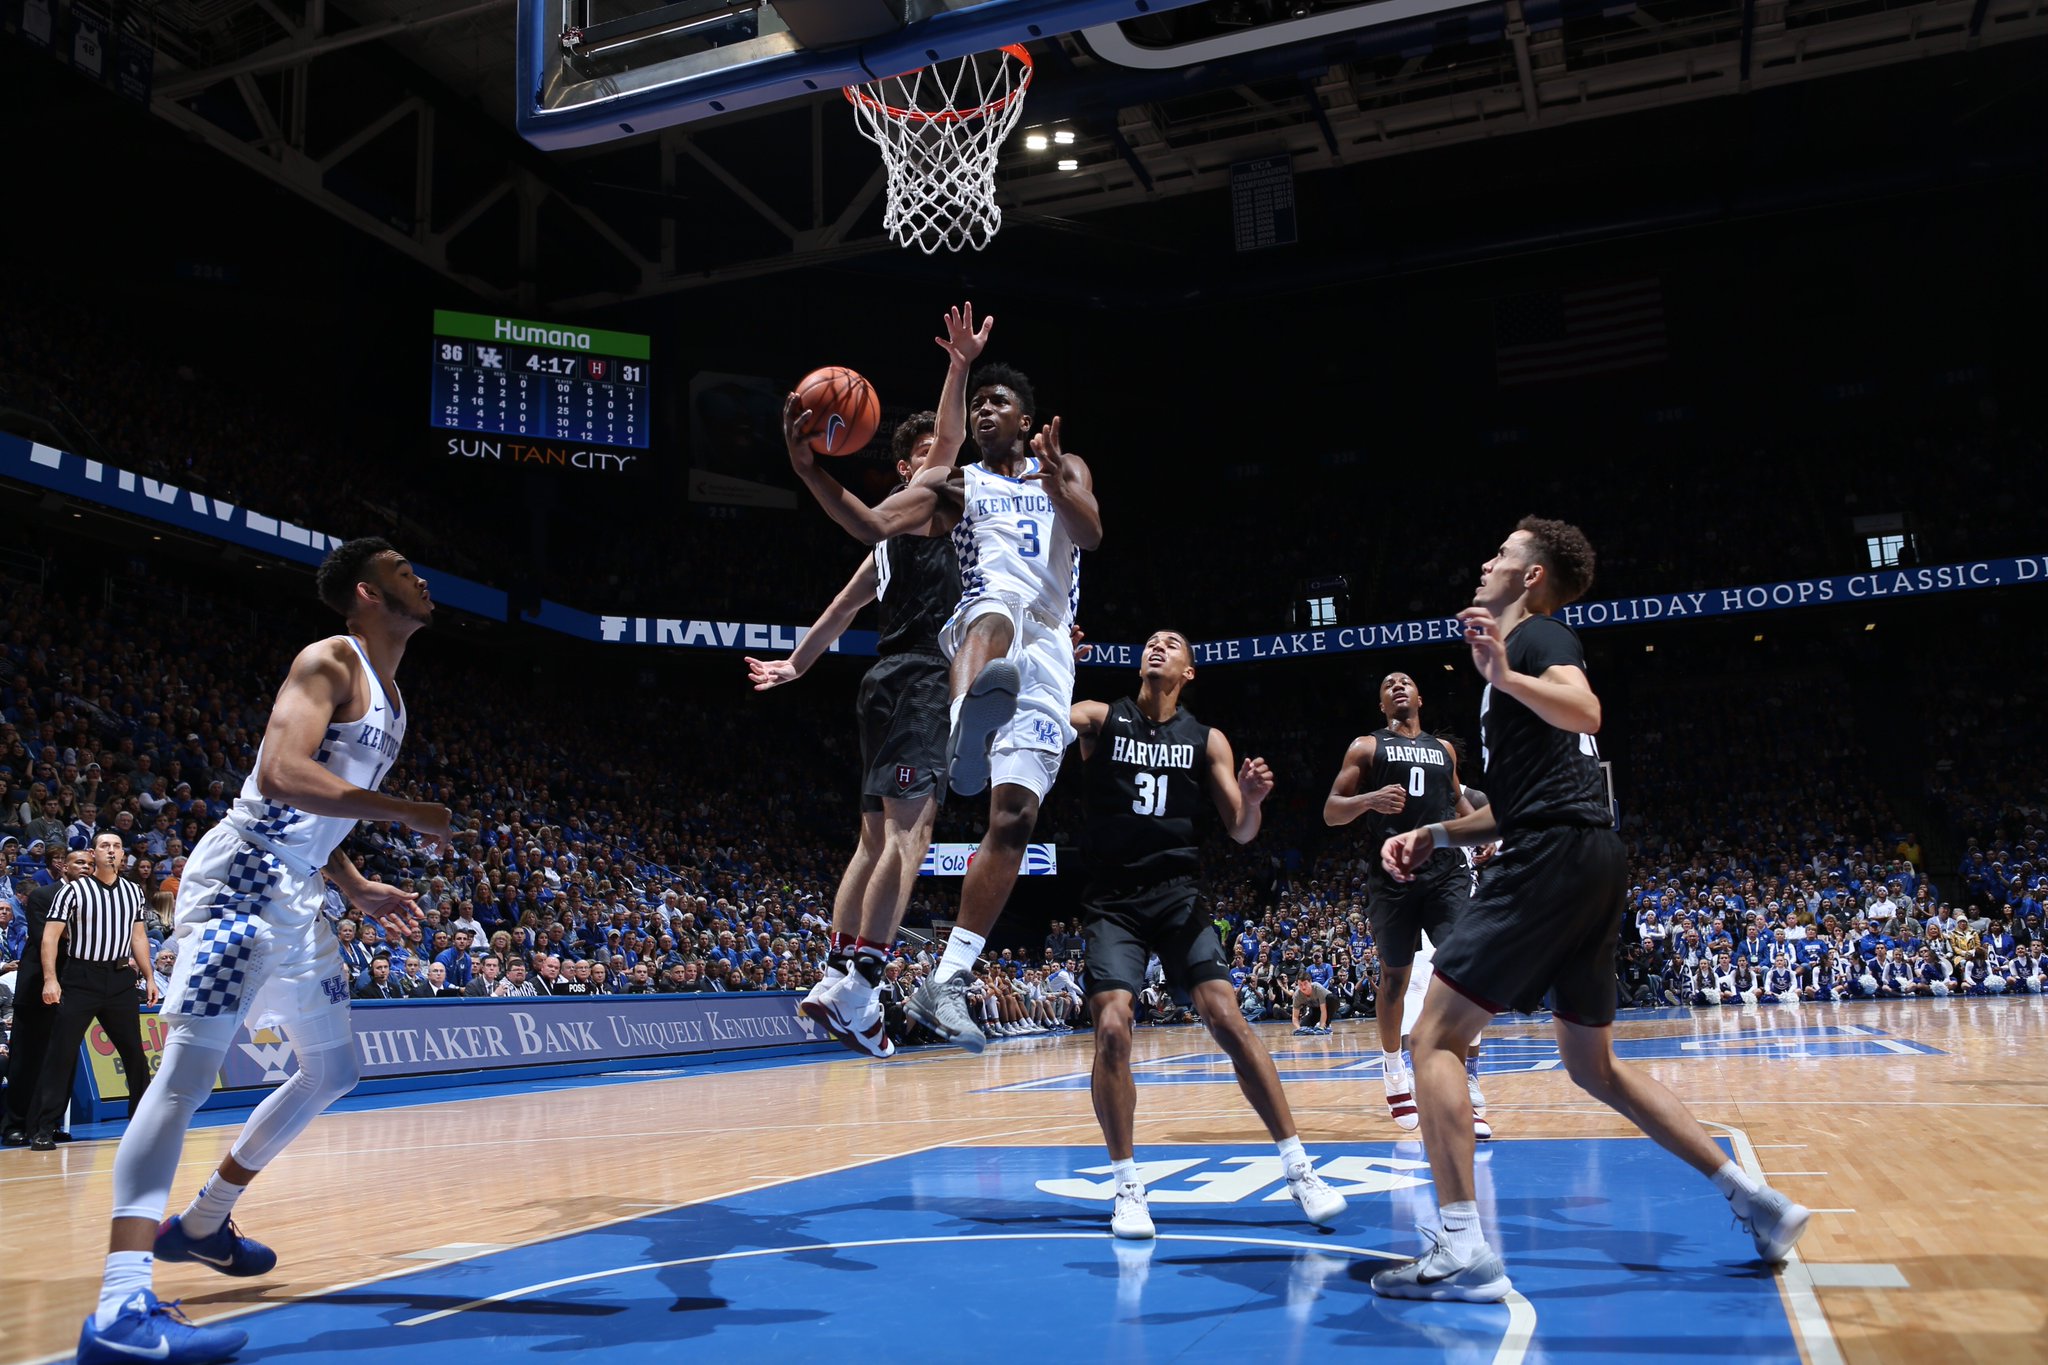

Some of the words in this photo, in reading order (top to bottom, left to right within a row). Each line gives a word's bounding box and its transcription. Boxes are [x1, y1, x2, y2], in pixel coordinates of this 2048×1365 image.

[1250, 161, 1272, 171] UCA
[495, 319, 590, 349] Humana
[442, 344, 462, 361] 36
[526, 355, 576, 375] 4:17
[592, 362, 602, 374] H
[623, 366, 640, 382] 31
[454, 373, 459, 381] 1
[478, 375, 484, 383] 2
[500, 378, 506, 386] 0
[520, 380, 526, 388] 0
[453, 384, 459, 392] 3
[478, 387, 484, 395] 8
[500, 389, 506, 397] 2
[521, 391, 526, 399] 1
[558, 384, 569, 393] 00
[609, 390, 613, 398] 1
[628, 392, 633, 400] 1
[453, 395, 459, 403] 5
[472, 397, 484, 405] 16
[499, 400, 506, 408] 4
[520, 403, 526, 411] 0
[558, 396, 569, 404] 11
[587, 399, 593, 407] 5
[608, 401, 614, 409] 0
[446, 406, 459, 415] 22
[477, 410, 484, 418] 4
[500, 412, 505, 420] 1
[520, 414, 526, 422] 0
[557, 407, 569, 415] 25
[587, 410, 593, 418] 0
[608, 412, 614, 420] 0
[446, 418, 458, 427] 32
[477, 421, 483, 429] 2
[500, 423, 505, 431] 1
[520, 426, 526, 434] 0
[557, 418, 569, 427] 30
[587, 421, 593, 429] 6
[608, 424, 613, 432] 1
[627, 426, 633, 434] 0
[557, 429, 568, 438] 31
[581, 432, 593, 441] 12
[608, 435, 614, 443] 2
[628, 437, 633, 445] 1
[448, 439, 501, 459] SUN
[507, 444, 566, 465] TAN
[571, 452, 631, 471] CITY
[1017, 520, 1040, 557] 3
[1076, 643, 1131, 664] OME
[1191, 641, 1240, 663] THE
[1252, 630, 1326, 656] LAKE
[1339, 618, 1470, 648] CUMBER
[1563, 593, 1707, 626] HOLIDAY
[1721, 579, 1833, 612] HOOPS
[1847, 562, 2001, 598] CLASSIC,
[1033, 718, 1061, 748] UK
[1111, 736, 1194, 769] HARVARD
[1385, 745, 1444, 766] HARVARD
[899, 768, 911, 782] H
[1409, 766, 1425, 796] 0
[1132, 772, 1168, 817] 31
[320, 975, 350, 1004] UK
[568, 983, 586, 993] POSS
[356, 1025, 511, 1066] HITAKER
[509, 1012, 602, 1055] BANK
[607, 1015, 703, 1050] UNIQUELY
[704, 1011, 792, 1041] KENTUCKY
